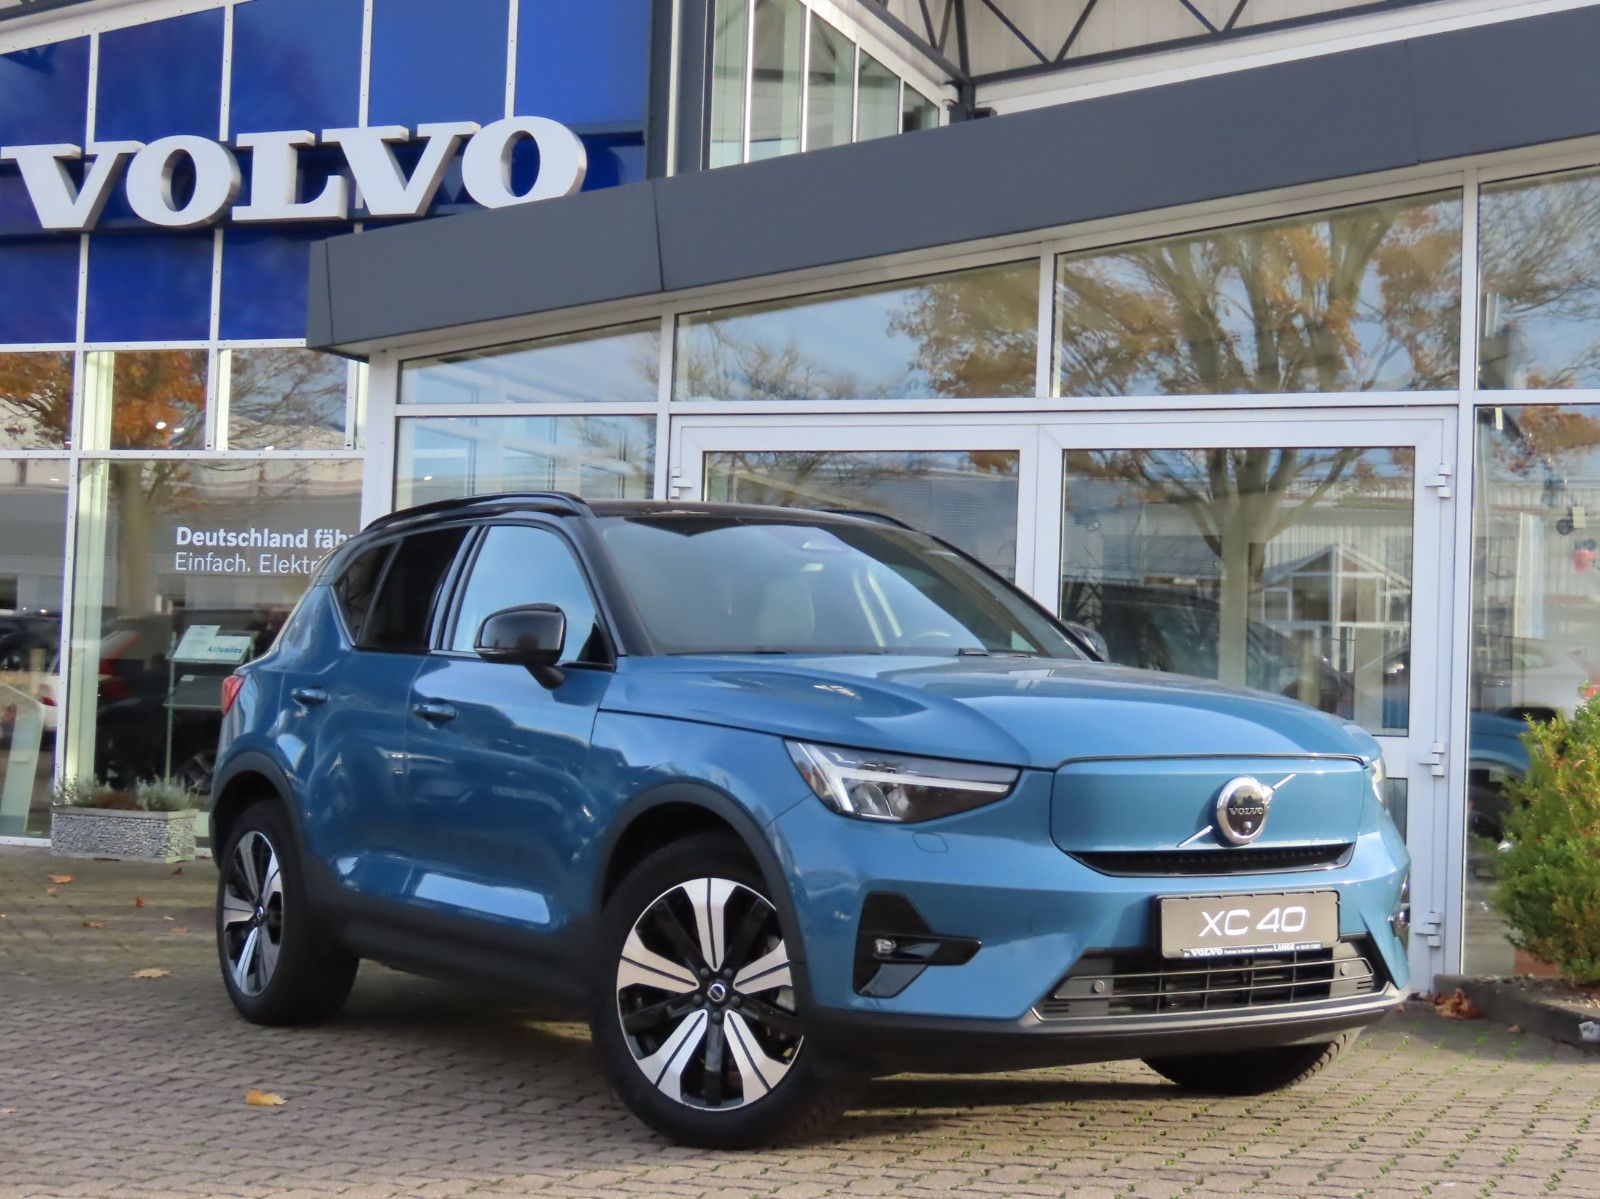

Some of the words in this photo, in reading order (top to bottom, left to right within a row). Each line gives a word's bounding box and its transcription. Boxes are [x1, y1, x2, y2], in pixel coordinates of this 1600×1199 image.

[0, 115, 587, 231] VOLVO
[176, 526, 308, 548] Deutschland
[175, 551, 251, 573] Einfach.
[259, 553, 322, 574] Elektr
[1228, 806, 1264, 815] VOLVO
[1199, 909, 1250, 937] XC
[1256, 906, 1306, 933] 40
[1190, 948, 1223, 957] VOLVO
